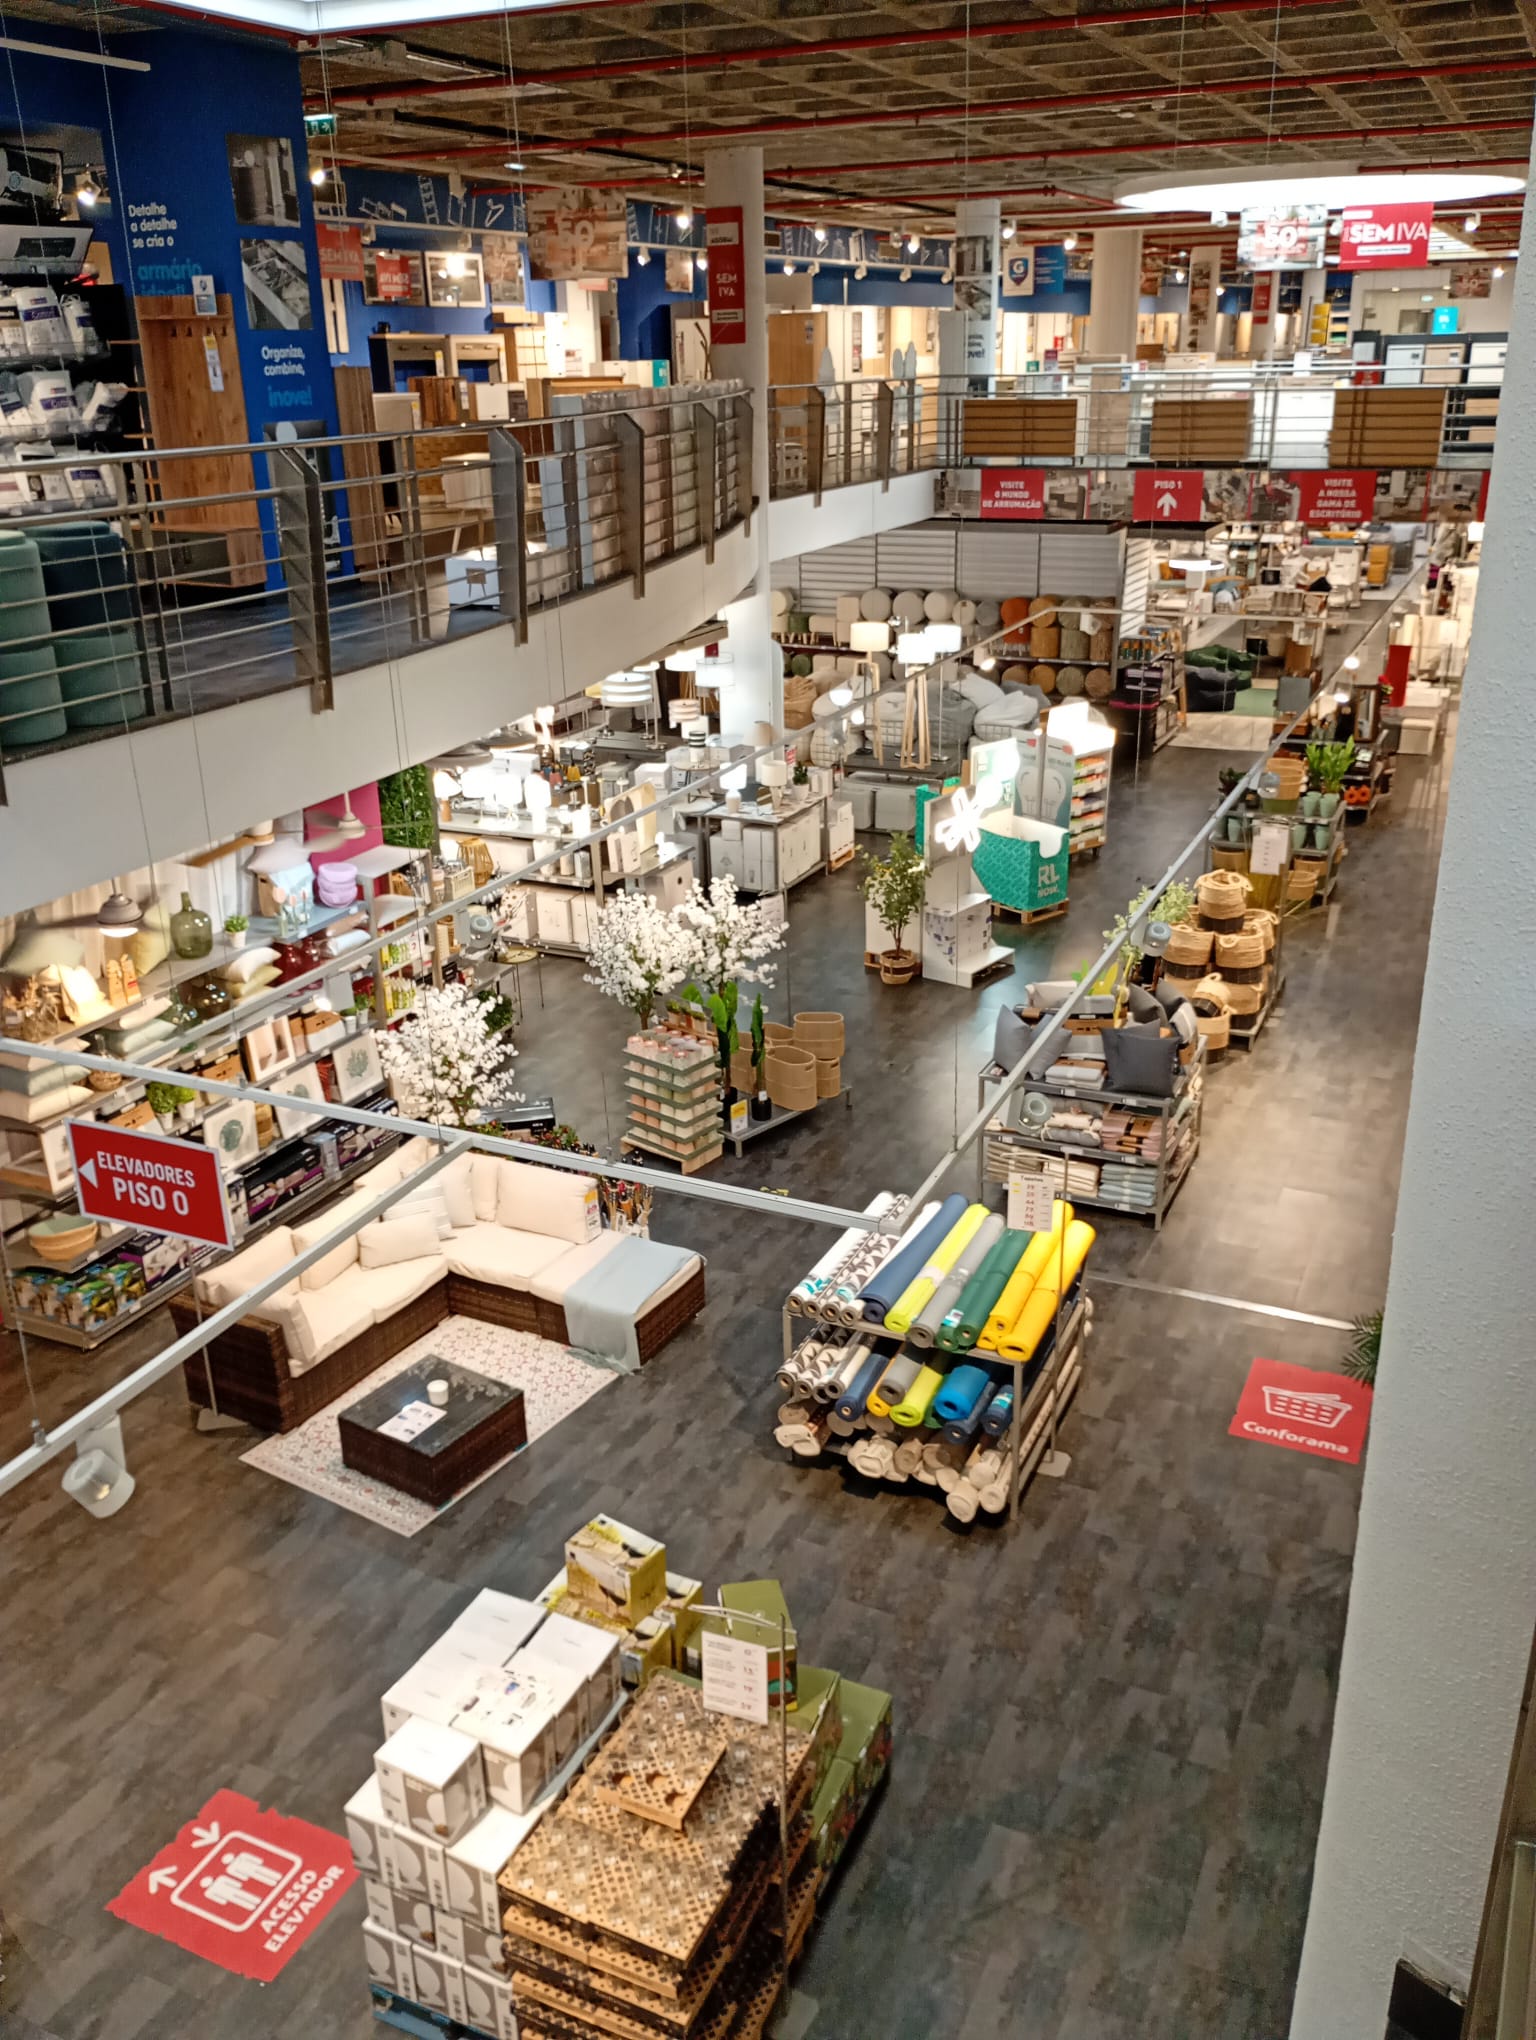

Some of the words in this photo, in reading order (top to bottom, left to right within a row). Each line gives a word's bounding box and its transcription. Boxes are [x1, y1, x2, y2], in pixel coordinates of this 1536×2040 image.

[128, 203, 168, 217] Detalhe
[130, 223, 138, 233] a
[140, 217, 178, 232] detalhe
[1349, 221, 1396, 244] SEM
[1396, 221, 1429, 242] IVA
[132, 238, 145, 249] se
[146, 234, 165, 248] cria
[166, 235, 175, 247] o
[138, 258, 203, 280] armário
[716, 273, 737, 284] SEM
[718, 286, 736, 297] IVA
[261, 344, 305, 362] Organize,
[263, 361, 305, 376] combine,
[268, 385, 312, 408] inove!
[999, 480, 1025, 490] VISITE
[1154, 479, 1176, 490] PISO
[1177, 479, 1183, 489] 1
[1324, 478, 1354, 488] VISITE
[1001, 490, 1030, 499] MUNDO
[1318, 489, 1326, 497] A
[1326, 489, 1357, 498] NOSSA
[982, 499, 993, 509] DE
[993, 499, 1041, 510] ARRUMAÇÃO
[1316, 499, 1342, 508] GAMA
[1343, 499, 1356, 508] DE
[1309, 509, 1363, 519] ESCRITÓRIO
[96, 1150, 197, 1189] ELEVADORES
[112, 1176, 167, 1211] PISO
[1243, 1420, 1350, 1455] Conforama
[261, 1870, 317, 1934] ACESSO
[264, 1865, 345, 1952] ELEVADOR
